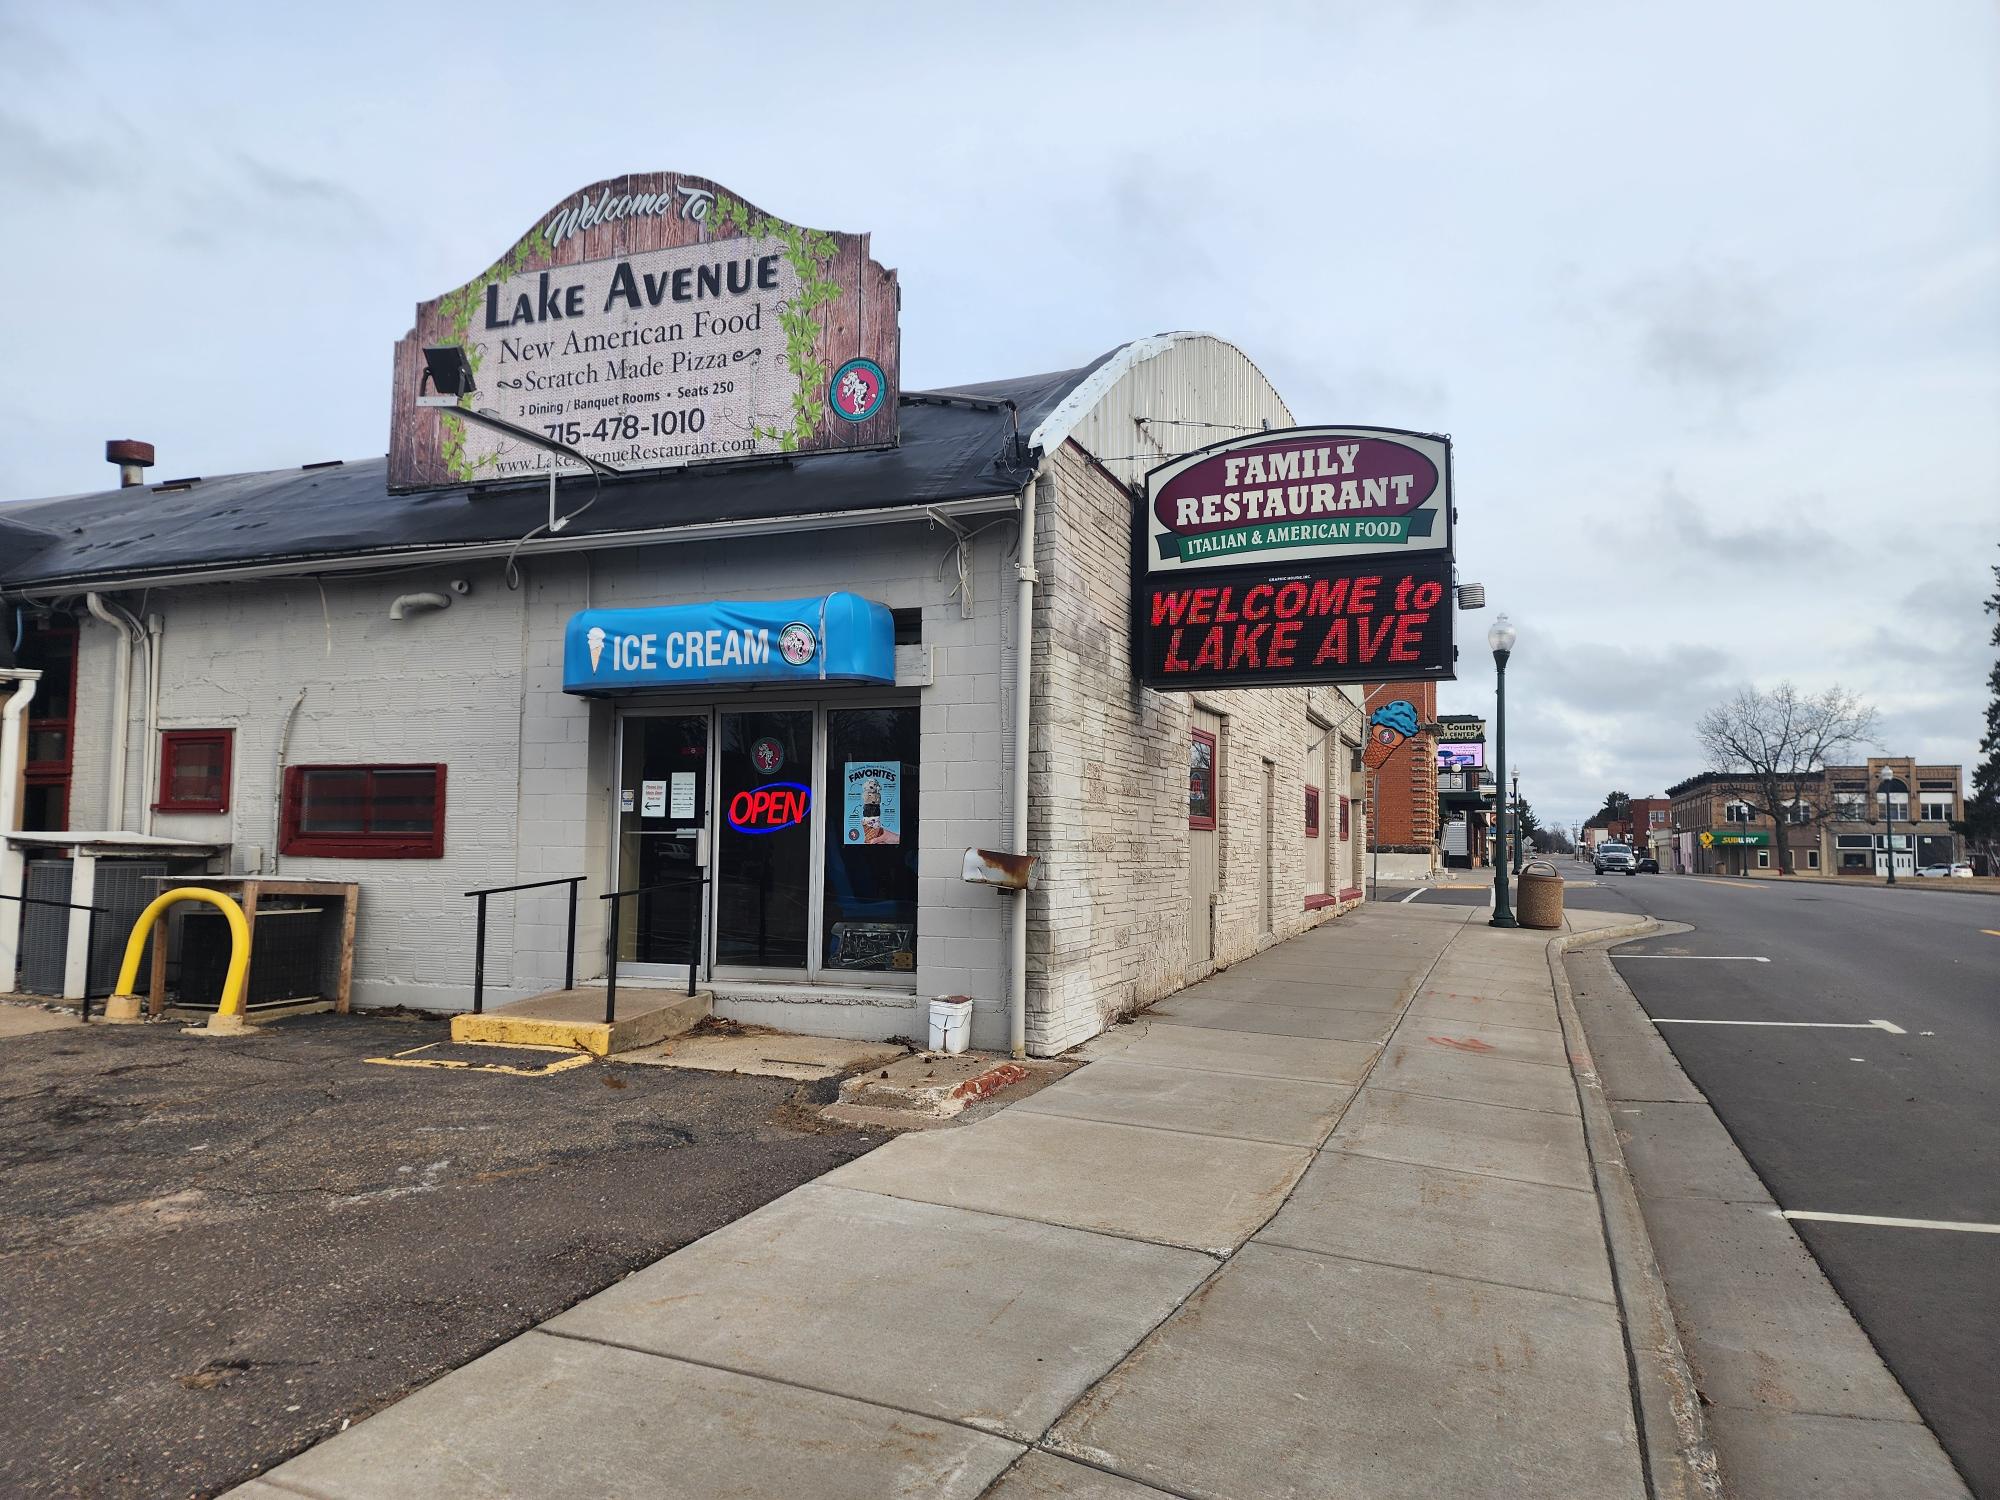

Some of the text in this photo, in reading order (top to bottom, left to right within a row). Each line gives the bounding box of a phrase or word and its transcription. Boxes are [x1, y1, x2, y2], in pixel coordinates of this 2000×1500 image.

[544, 184, 715, 248] Welcome To
[498, 303, 762, 365] New American Food
[525, 350, 728, 391] Scratch Made Pizza
[519, 405, 525, 416] 3
[528, 401, 563, 416] Dining
[573, 396, 619, 411] Banquet
[622, 391, 660, 405] Rooms
[677, 385, 709, 398] Seats
[712, 381, 734, 394] 250
[543, 408, 706, 445] 715-478-1010
[496, 438, 757, 473] www.LakevenueRestaurant.com
[1224, 444, 1361, 487] FAMILY
[1176, 474, 1414, 527] RESTAURANT
[1188, 521, 1402, 555] ITALIAN & AMERICAN FOOD
[1150, 575, 1442, 627] WELCOME to
[613, 634, 657, 671] ICE
[666, 629, 769, 668] CREAM
[1162, 613, 1431, 673] LAKE AVE
[1447, 723, 1482, 732] County
[848, 769, 896, 783] FAVORITES
[729, 791, 806, 824] OPEN
